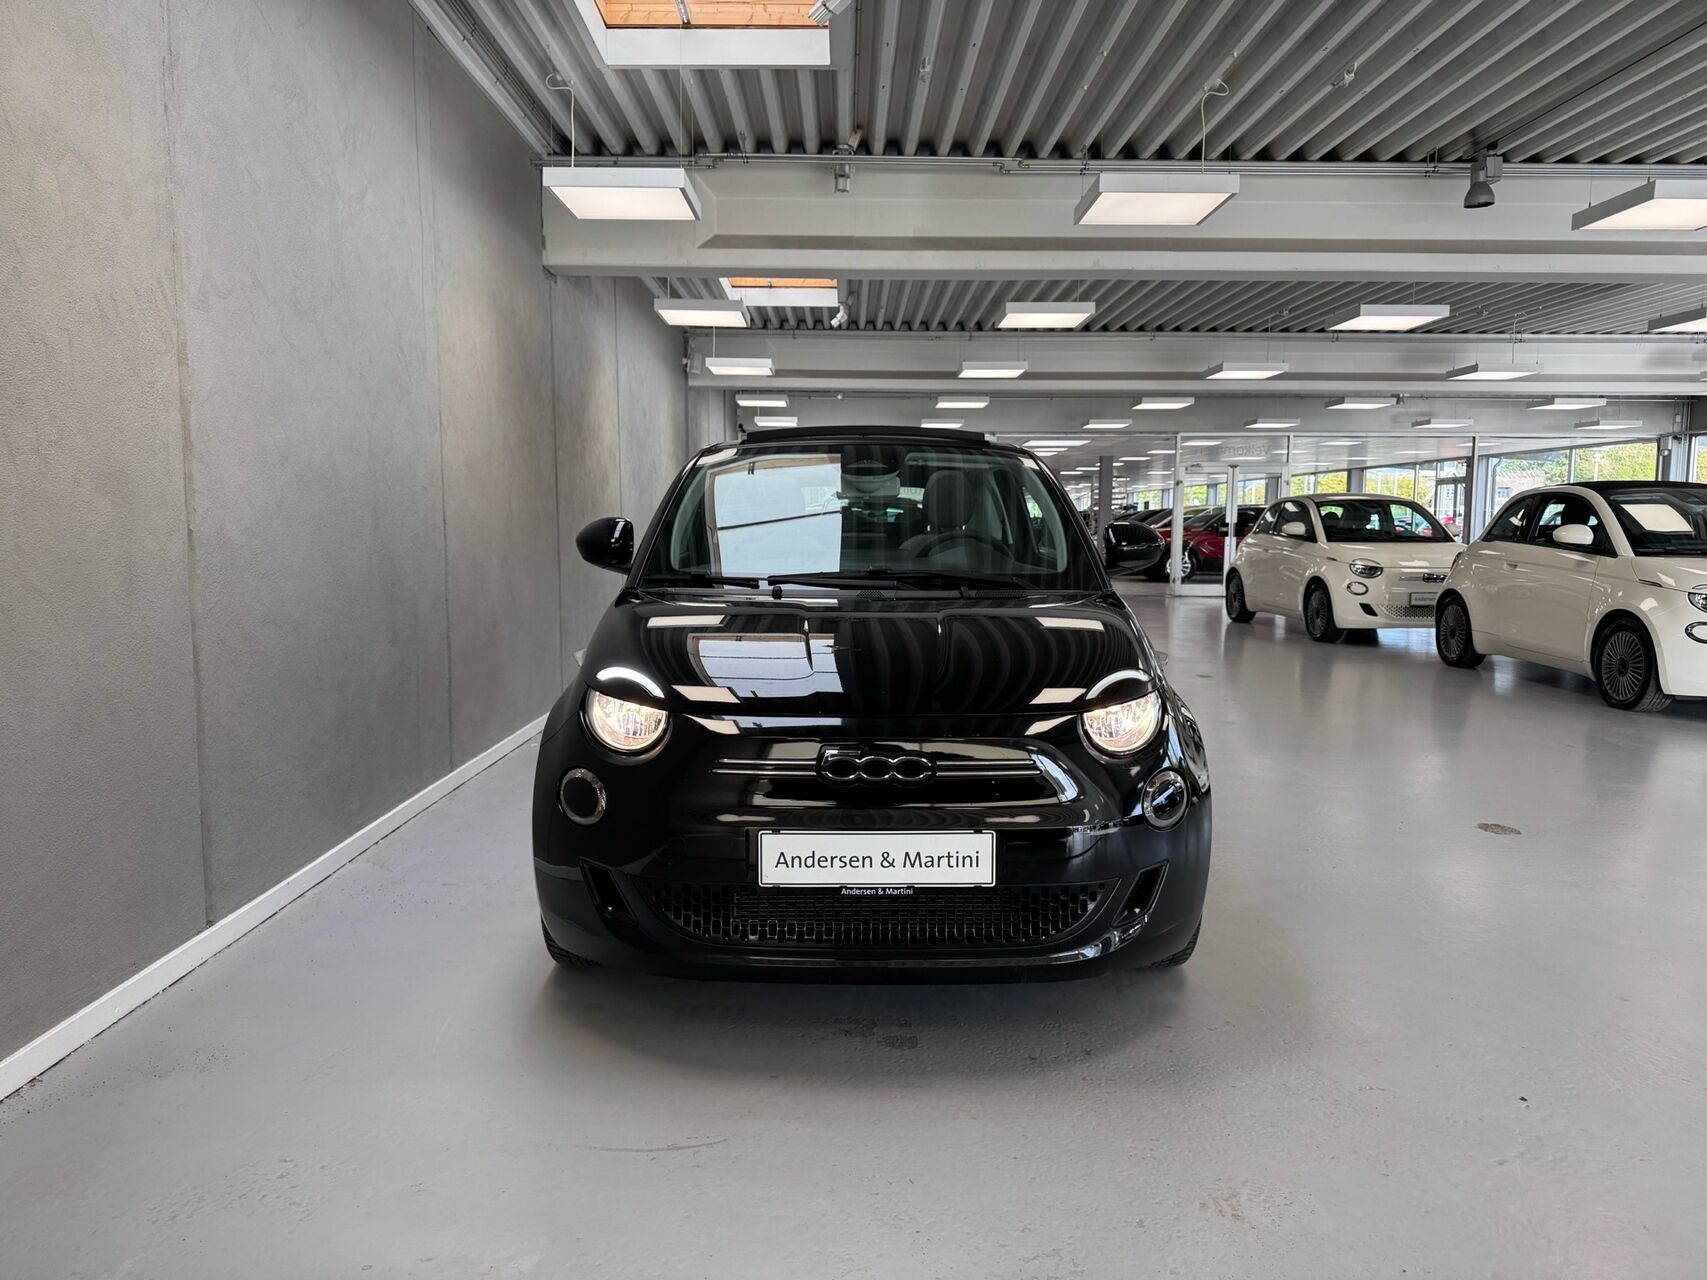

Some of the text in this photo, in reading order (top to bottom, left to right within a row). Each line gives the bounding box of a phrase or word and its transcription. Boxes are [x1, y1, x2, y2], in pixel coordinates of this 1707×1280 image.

[819, 746, 933, 781] 500
[775, 850, 980, 869] Andersen & Martini
[841, 887, 914, 895] Andersen & Martini
